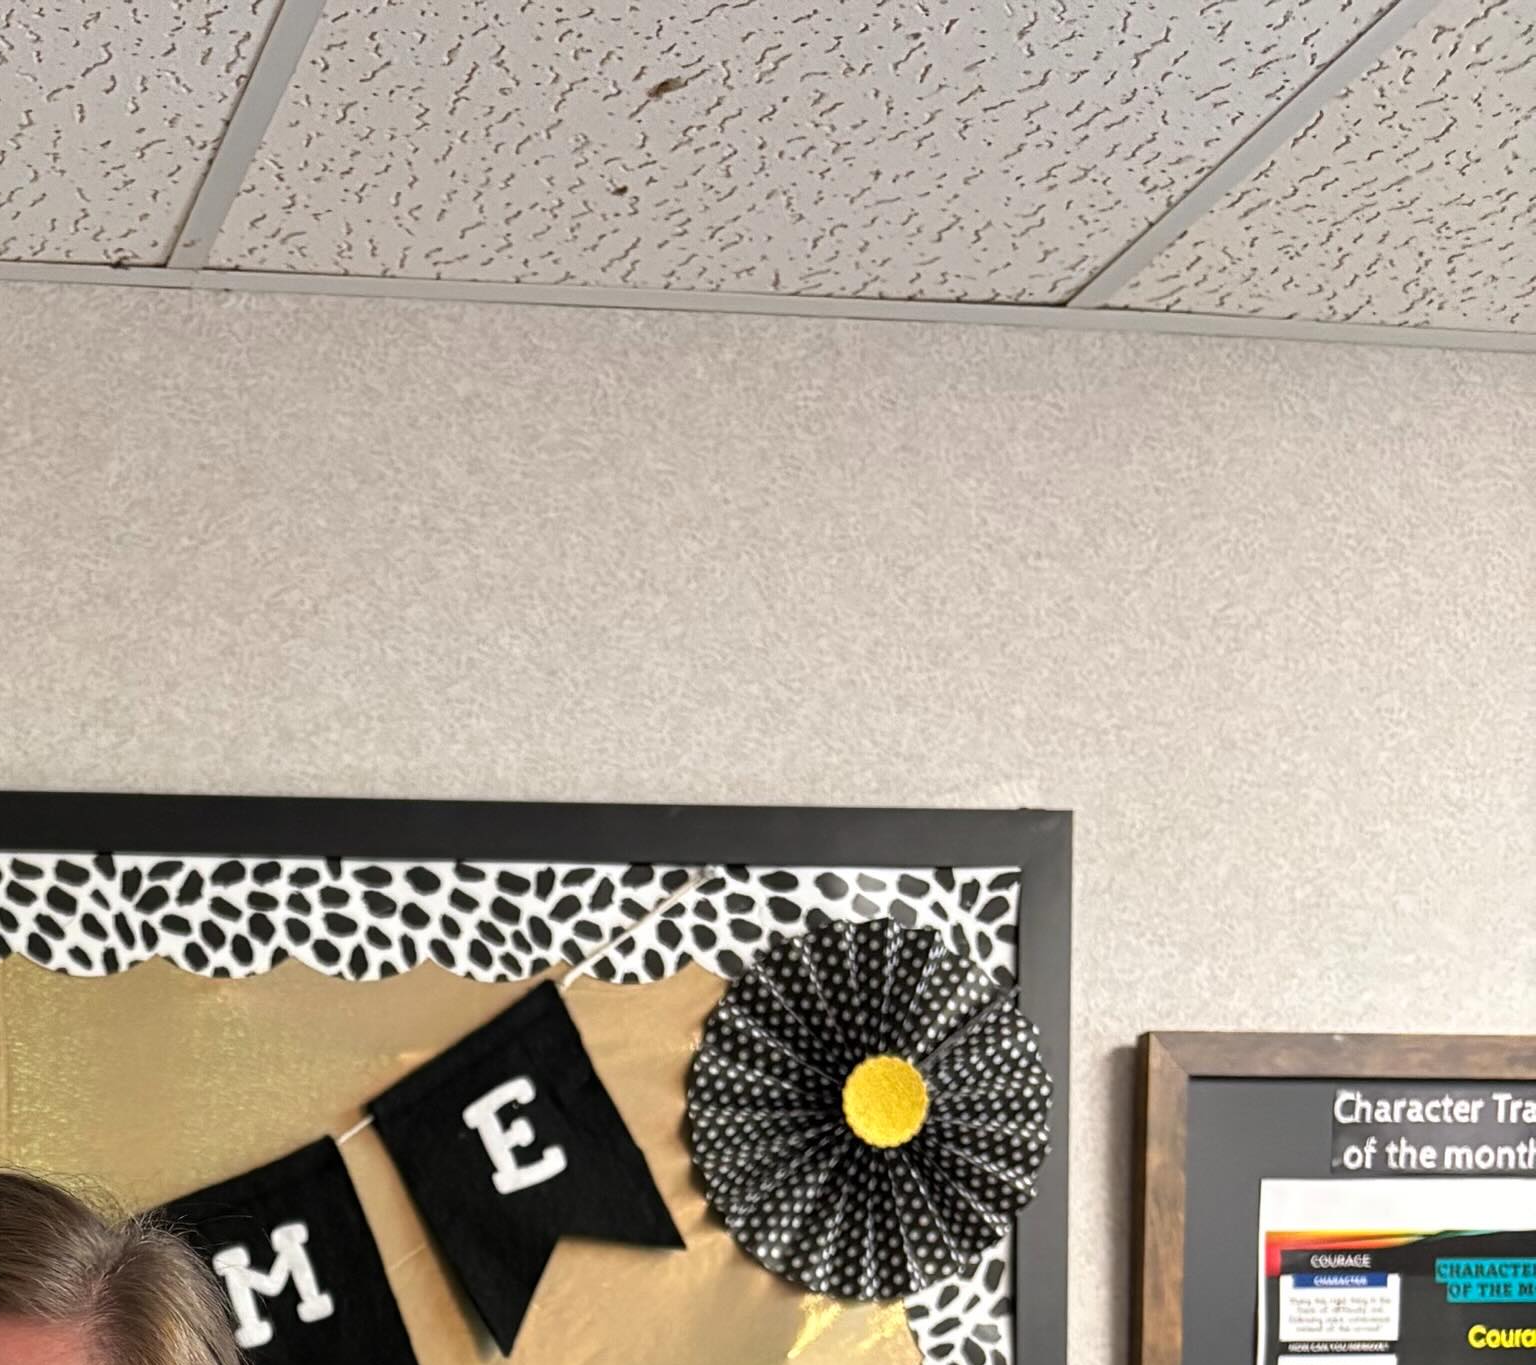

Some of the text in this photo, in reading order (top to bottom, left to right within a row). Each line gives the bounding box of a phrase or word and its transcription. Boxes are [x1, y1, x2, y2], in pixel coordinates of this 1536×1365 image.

[1334, 1090, 1485, 1124] Character
[1343, 1136, 1378, 1170] of
[1385, 1137, 1437, 1169] the
[1310, 1254, 1372, 1268] COURAGE
[1448, 1283, 1472, 1298] OF
[1477, 1282, 1512, 1297] THE
